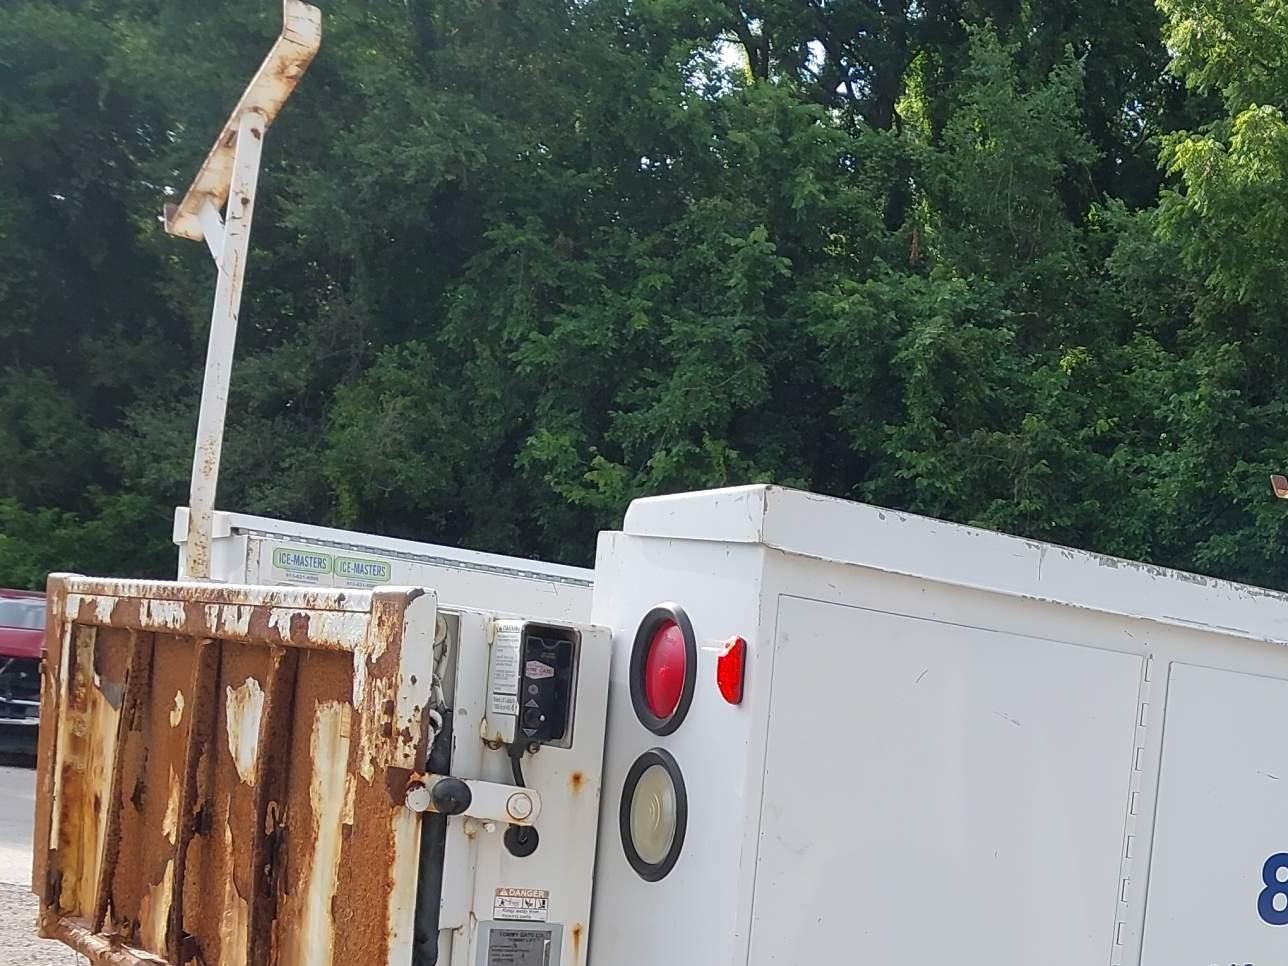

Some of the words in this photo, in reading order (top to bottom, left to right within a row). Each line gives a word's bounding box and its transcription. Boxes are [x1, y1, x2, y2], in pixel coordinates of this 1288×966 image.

[279, 552, 327, 569] ICE-MASTERS
[340, 561, 386, 577] ICE-MASTERS
[508, 889, 545, 898] DANGER
